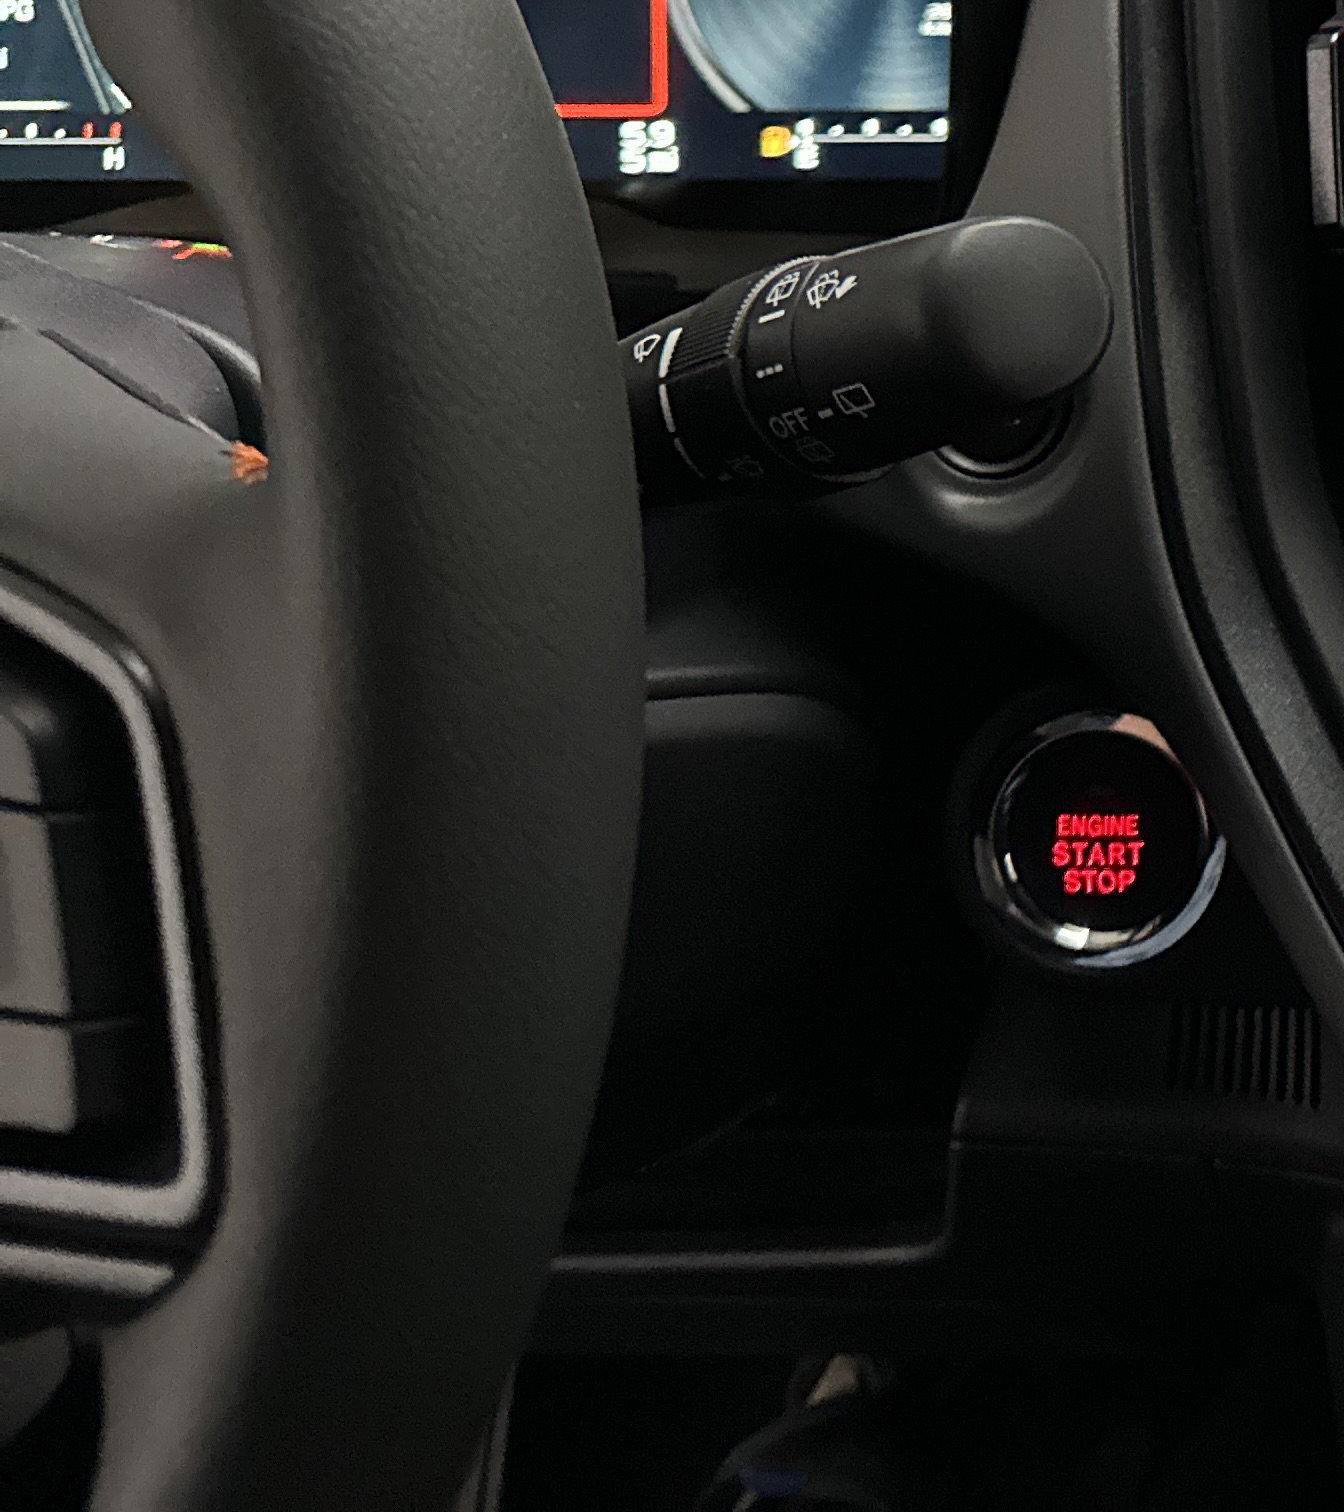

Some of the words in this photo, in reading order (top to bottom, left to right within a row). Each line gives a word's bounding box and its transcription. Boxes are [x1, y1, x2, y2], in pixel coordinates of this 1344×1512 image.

[102, 145, 126, 170] H
[768, 406, 810, 440] OFF
[1057, 813, 1140, 838] ENGINE
[1052, 841, 1145, 868] START
[1064, 870, 1136, 895] STOP
